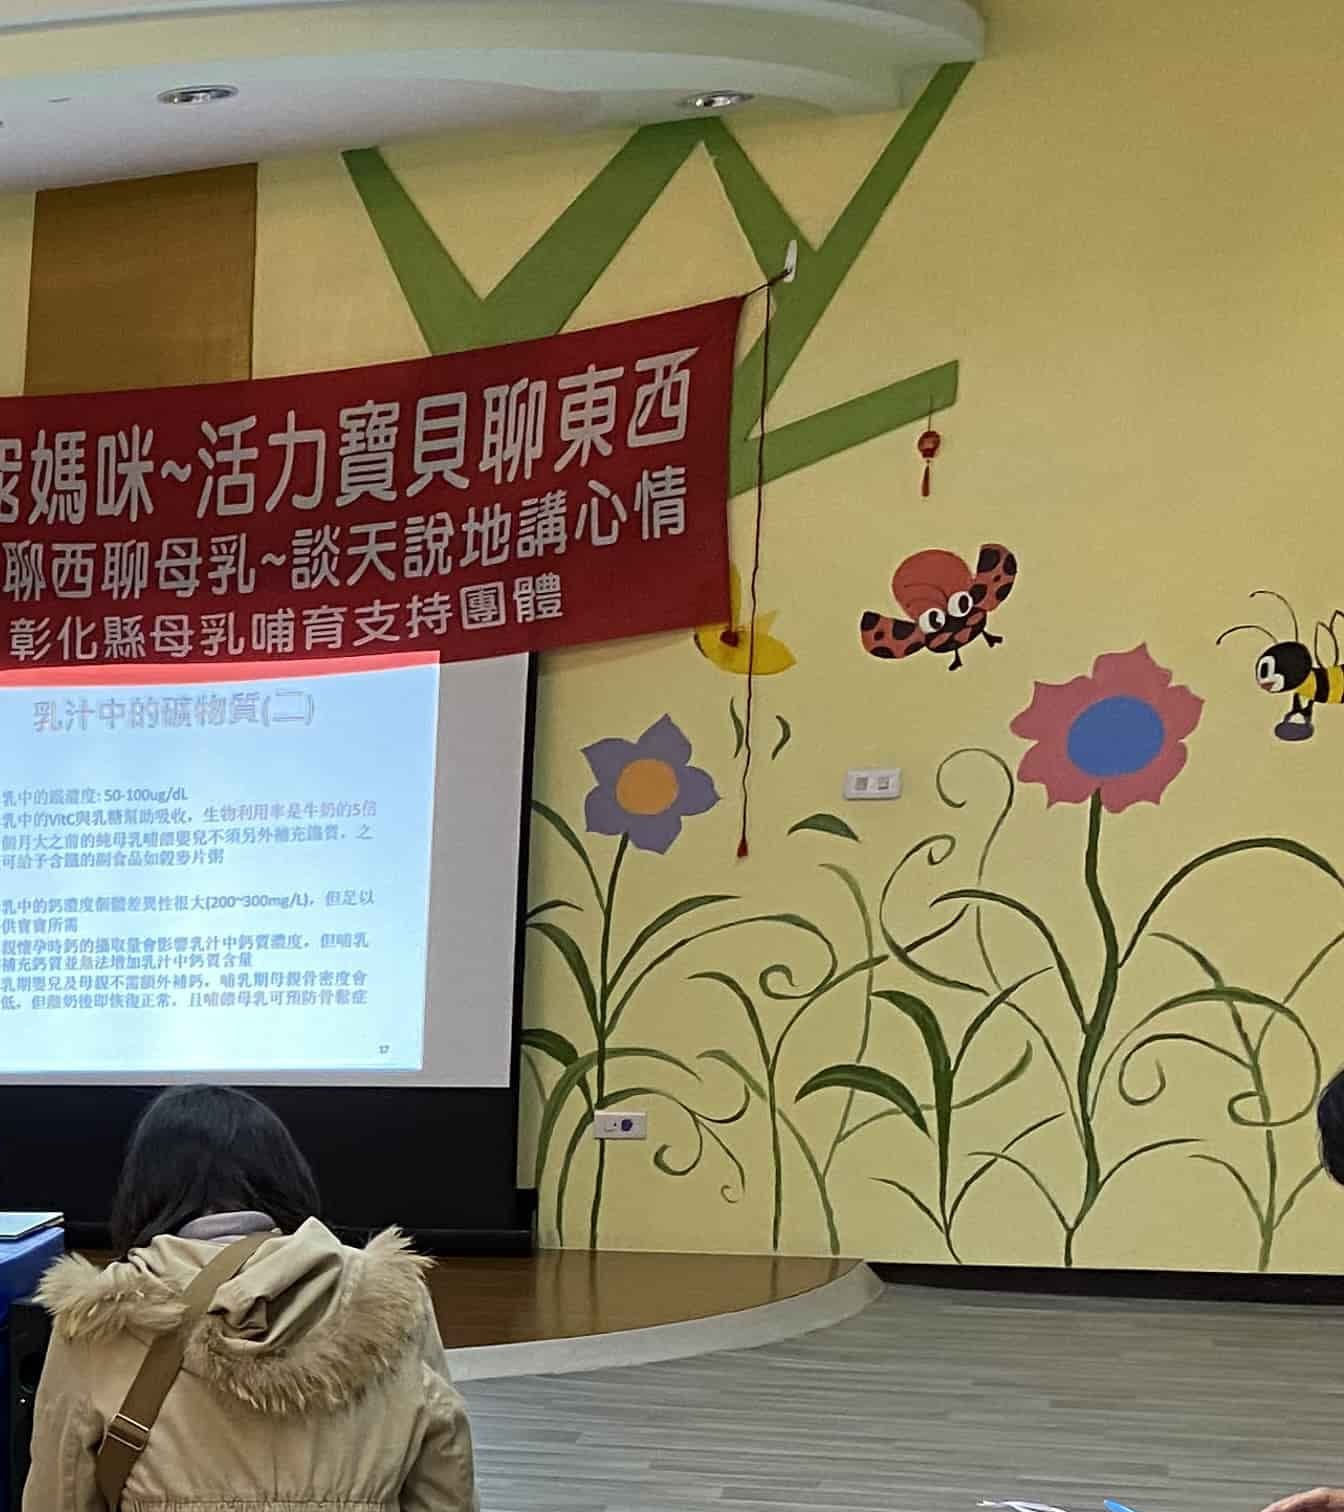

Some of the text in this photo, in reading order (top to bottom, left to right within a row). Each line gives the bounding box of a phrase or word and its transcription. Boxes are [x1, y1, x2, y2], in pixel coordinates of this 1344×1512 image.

[8, 573, 563, 662] 彰化縣母乳哺育支持團體
